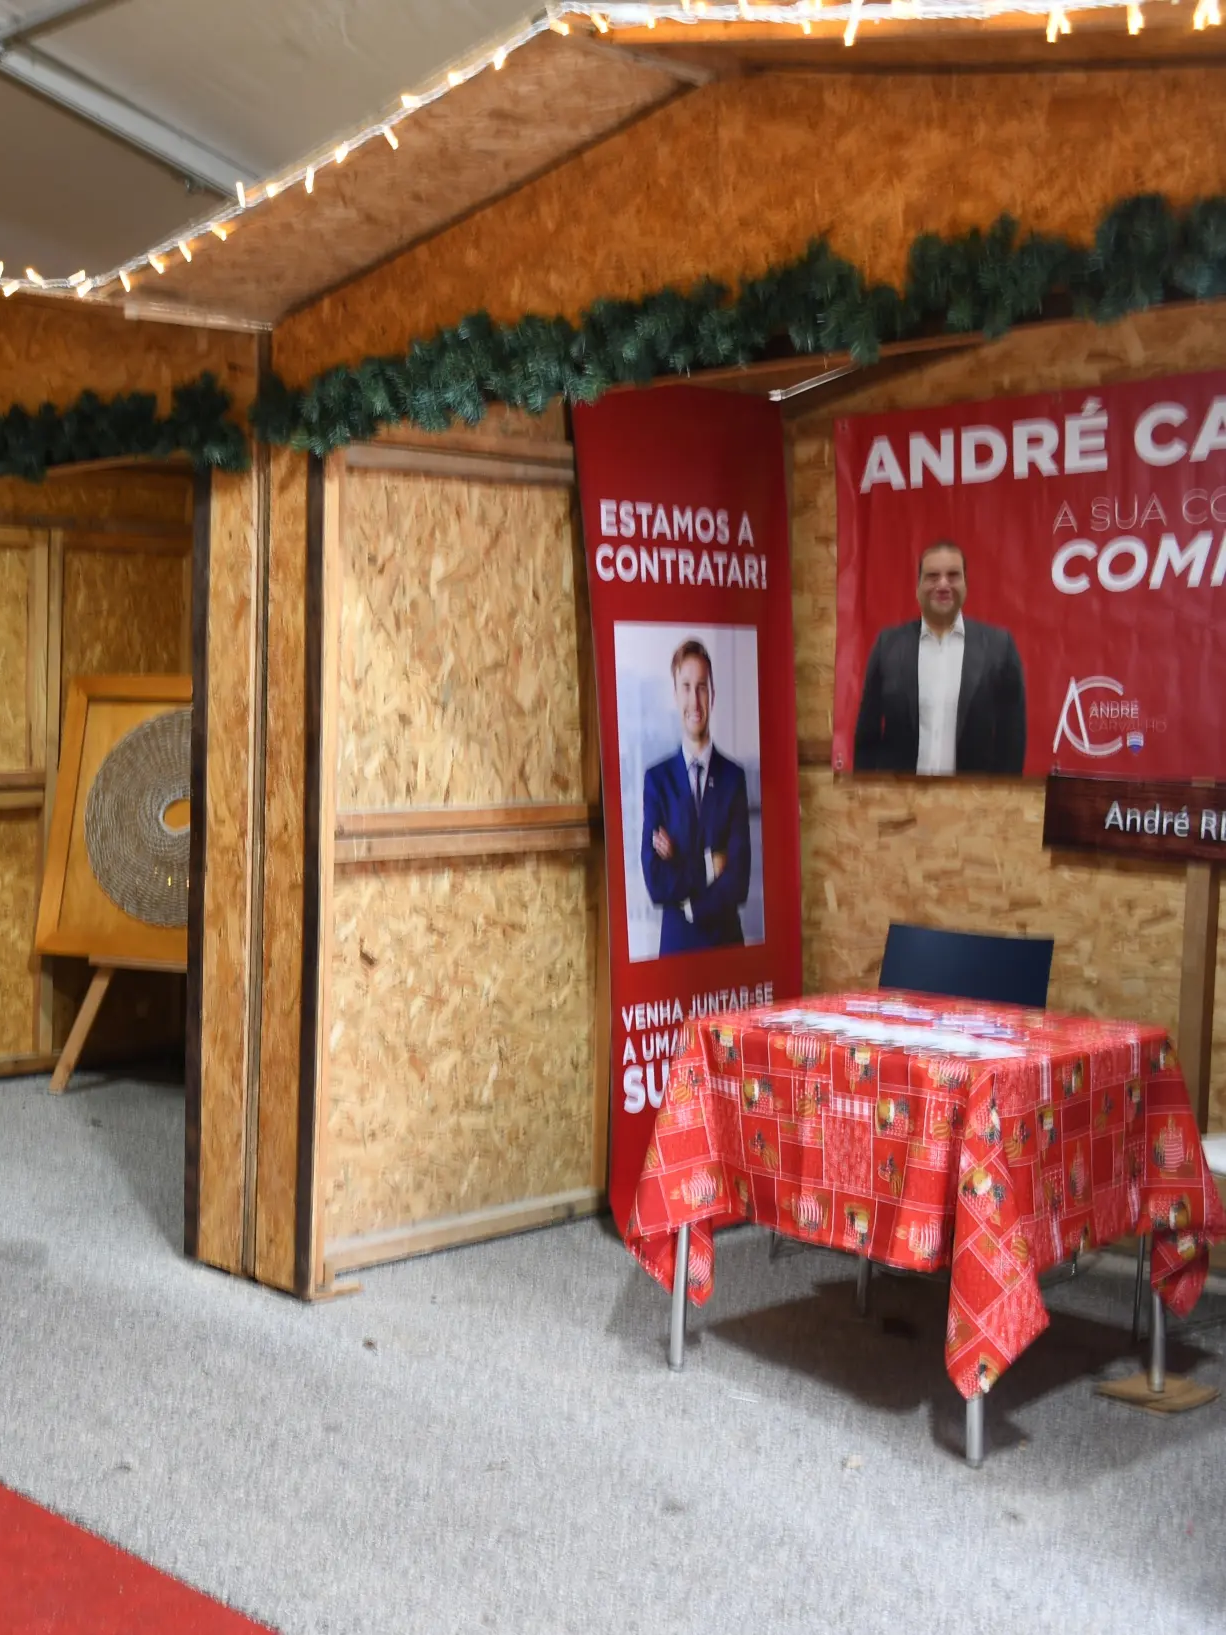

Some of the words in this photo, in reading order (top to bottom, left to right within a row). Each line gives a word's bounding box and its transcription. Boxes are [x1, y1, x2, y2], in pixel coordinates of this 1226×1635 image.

[860, 396, 1108, 494] ANDRÉ
[600, 498, 730, 545] ESTAMOS
[738, 510, 755, 547] A
[1053, 499, 1078, 535] A
[1090, 492, 1167, 532] SUA
[596, 543, 767, 590] CONTRATAR!
[1104, 800, 1190, 838] André
[622, 997, 684, 1032] VENHA
[623, 1036, 637, 1066] A
